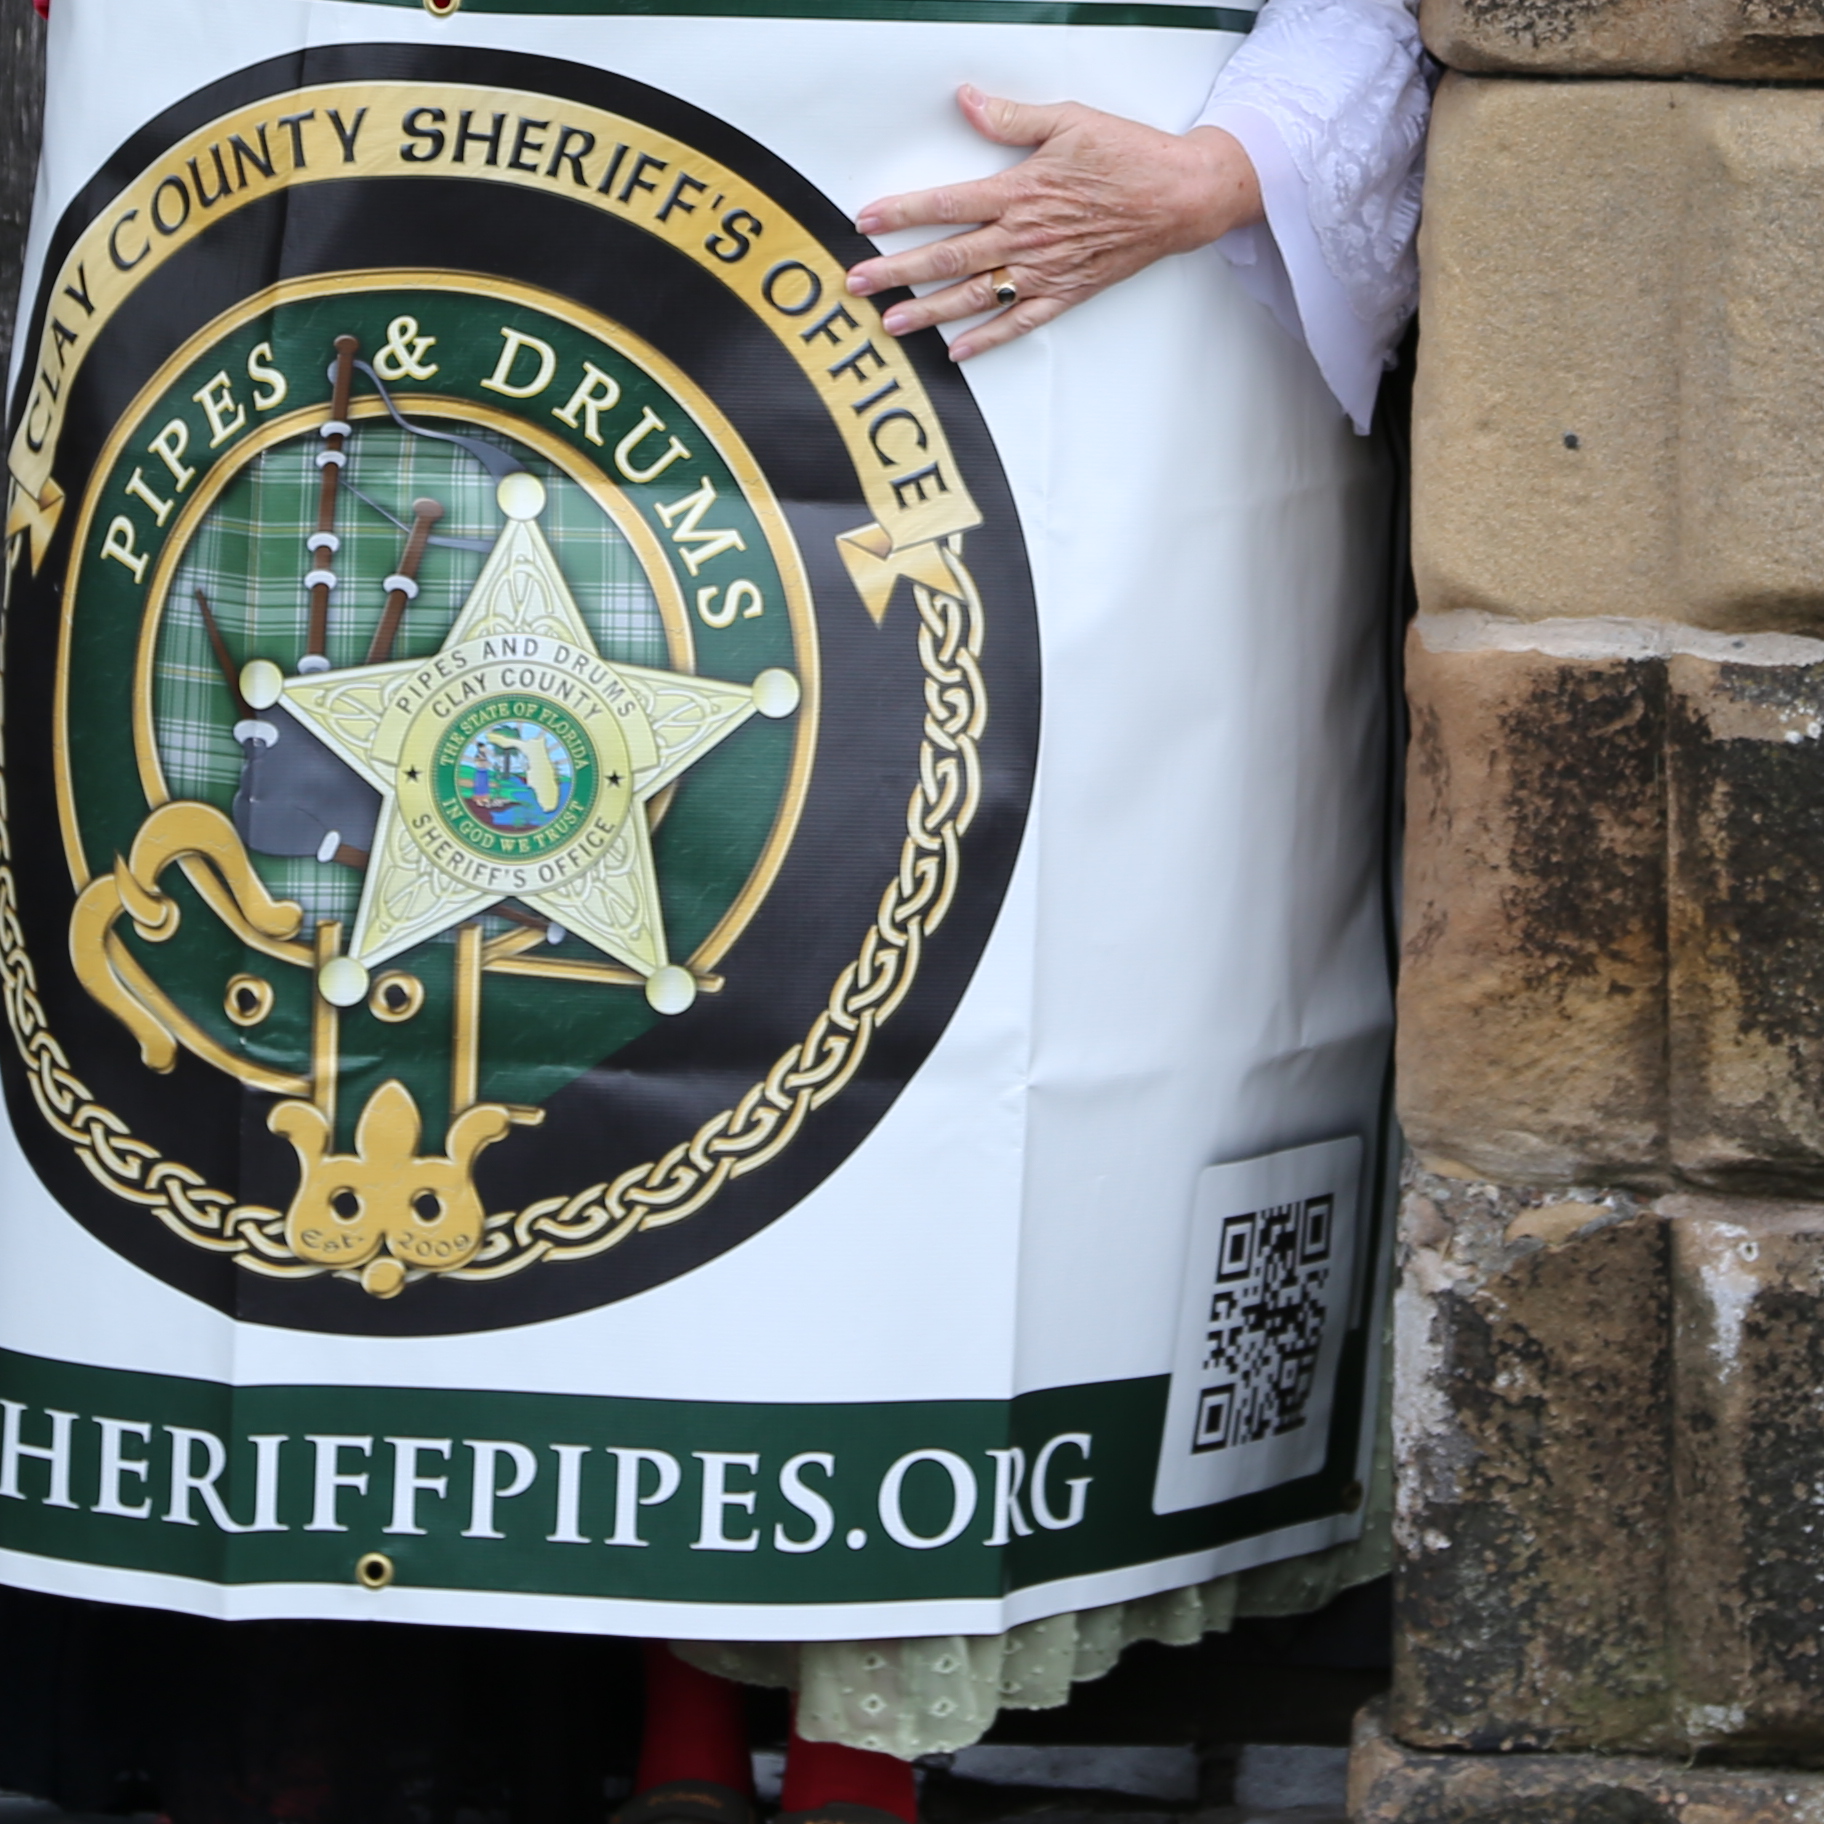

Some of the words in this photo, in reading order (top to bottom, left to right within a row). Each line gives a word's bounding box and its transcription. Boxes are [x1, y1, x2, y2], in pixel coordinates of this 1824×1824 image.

[26, 260, 96, 454] CLAY
[108, 107, 369, 272] COUNTY
[399, 106, 764, 263] SHERIFF'S
[761, 259, 949, 510] OFFICE
[100, 341, 289, 584] PIPES
[373, 315, 440, 382] &
[480, 326, 764, 629] DRUMS
[396, 650, 467, 715] PIPES
[482, 638, 539, 659] AND
[554, 645, 636, 717] DRUMS
[432, 672, 488, 718] CLAY
[501, 668, 603, 720] COUNTY
[440, 732, 466, 766] THE
[460, 702, 510, 735] STATE
[513, 702, 538, 717] OF
[539, 709, 590, 770] FLORIDA
[412, 814, 525, 888] SHERIFF'S
[539, 817, 614, 883] OFFICE
[442, 798, 463, 820] IN
[459, 820, 495, 849] GOD
[500, 838, 531, 853] WE
[533, 800, 584, 848] TRUST
[397, 1231, 471, 1257] 2009
